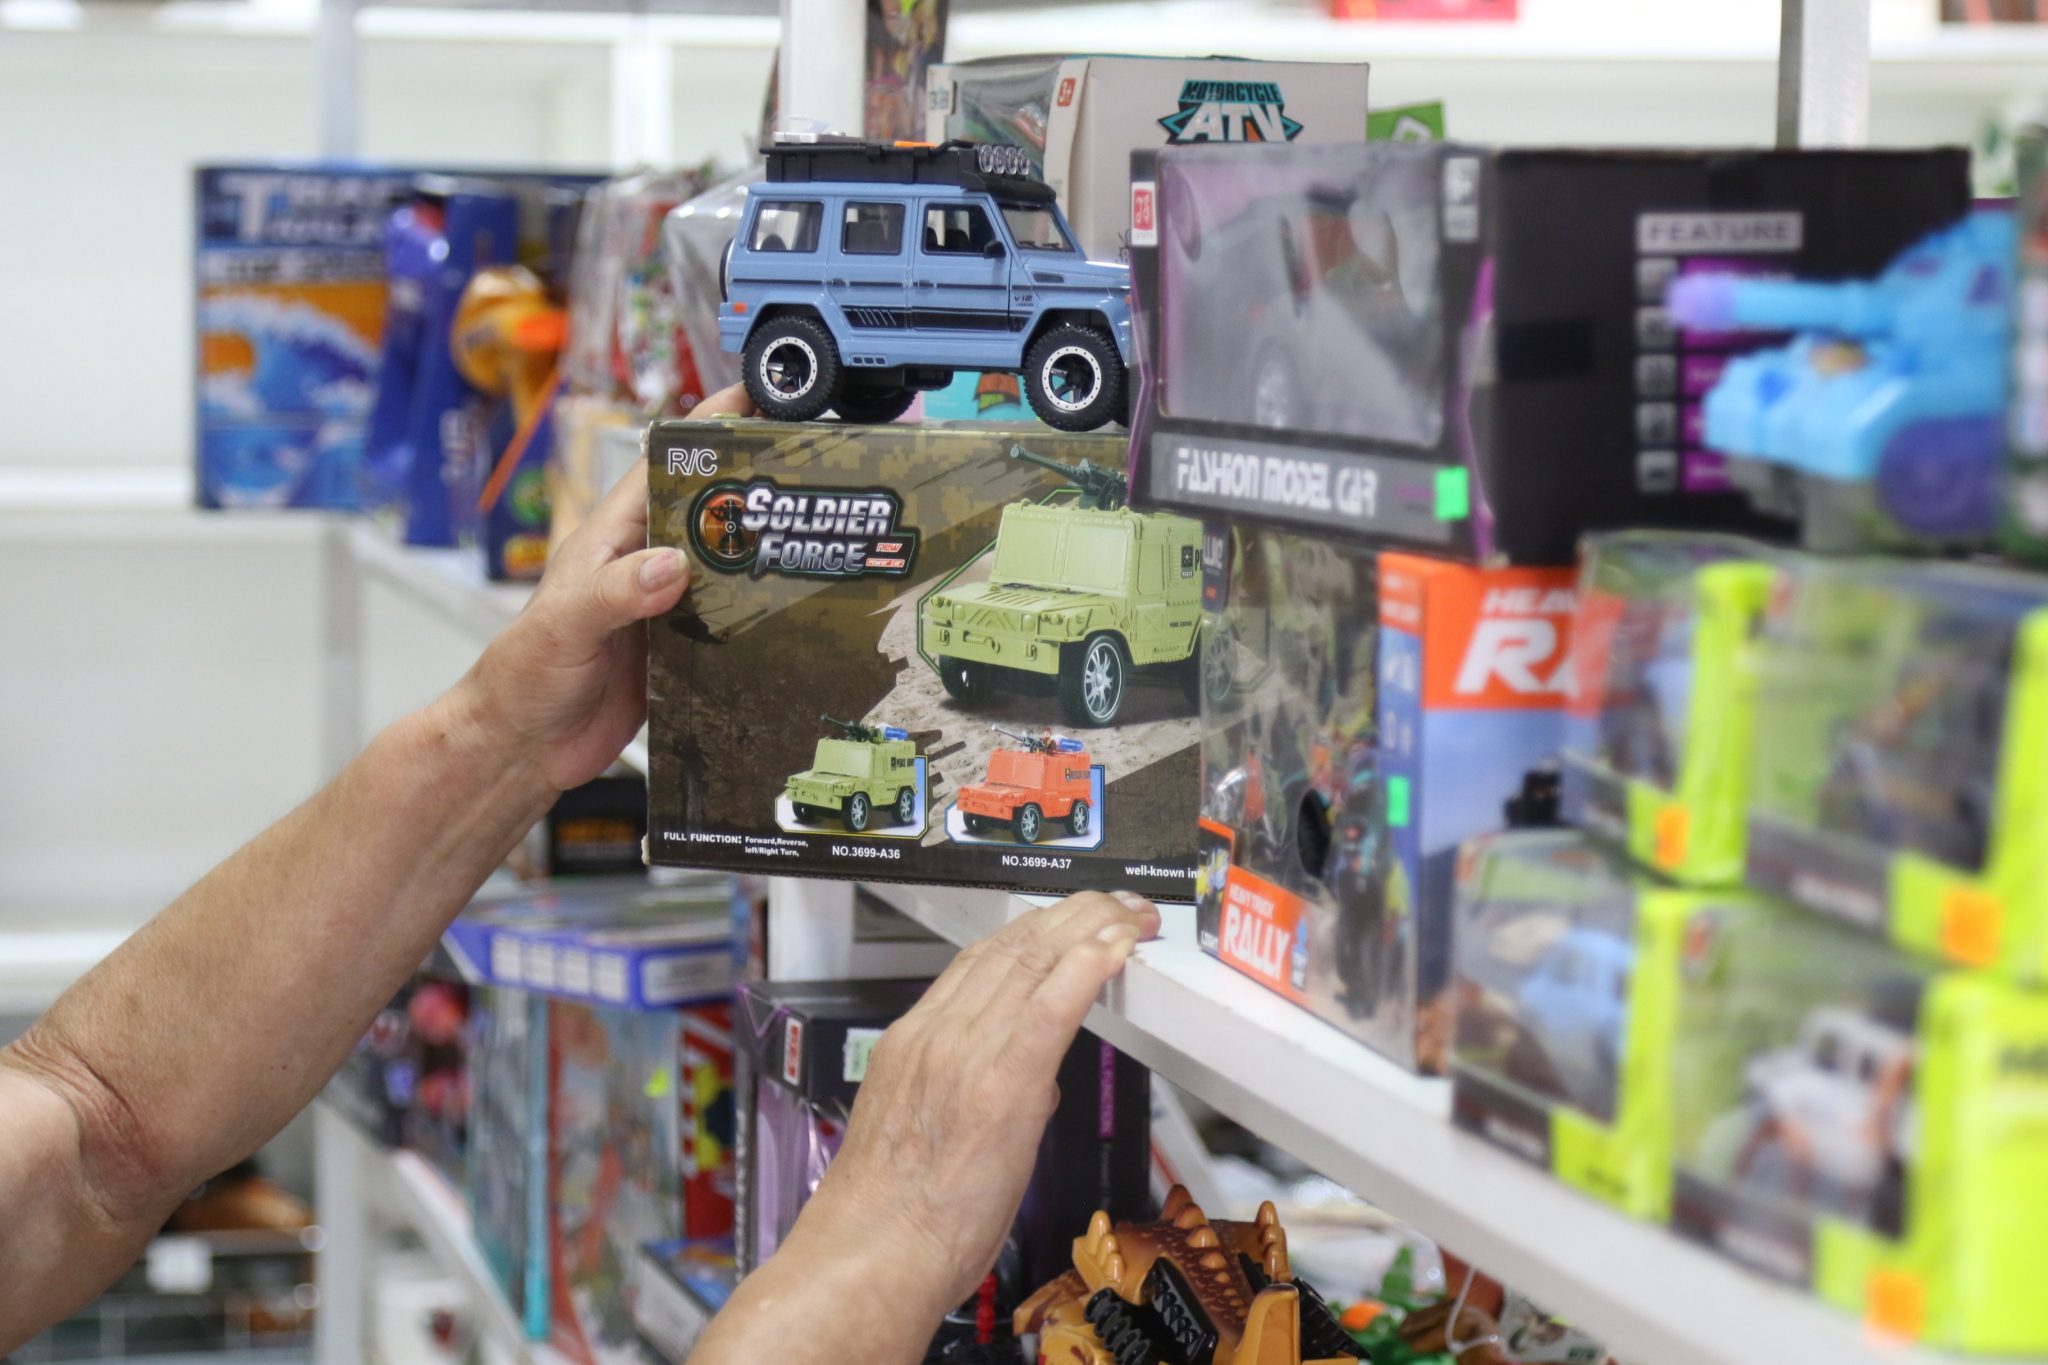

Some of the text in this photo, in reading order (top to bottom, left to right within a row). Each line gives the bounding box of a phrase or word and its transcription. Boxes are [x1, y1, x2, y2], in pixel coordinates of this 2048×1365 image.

[1058, 80, 1073, 103] 3+
[1183, 81, 1281, 102] MOTORCYCLE
[1177, 104, 1287, 142] ATV
[1651, 220, 1791, 241] FEATURE
[667, 448, 718, 476] R/C
[1177, 447, 1260, 500] FASHION
[1262, 457, 1332, 511] MODEL
[741, 487, 892, 537] SOLDIER
[754, 532, 868, 576] FORCE
[1482, 586, 1578, 614] HEA
[664, 831, 742, 845] FULL FUNCTION:
[832, 845, 901, 860] NO.3699-A36
[1001, 855, 1072, 870] NO.3699-A37
[1125, 864, 1185, 878] well-known
[1224, 903, 1291, 982] RALLY
